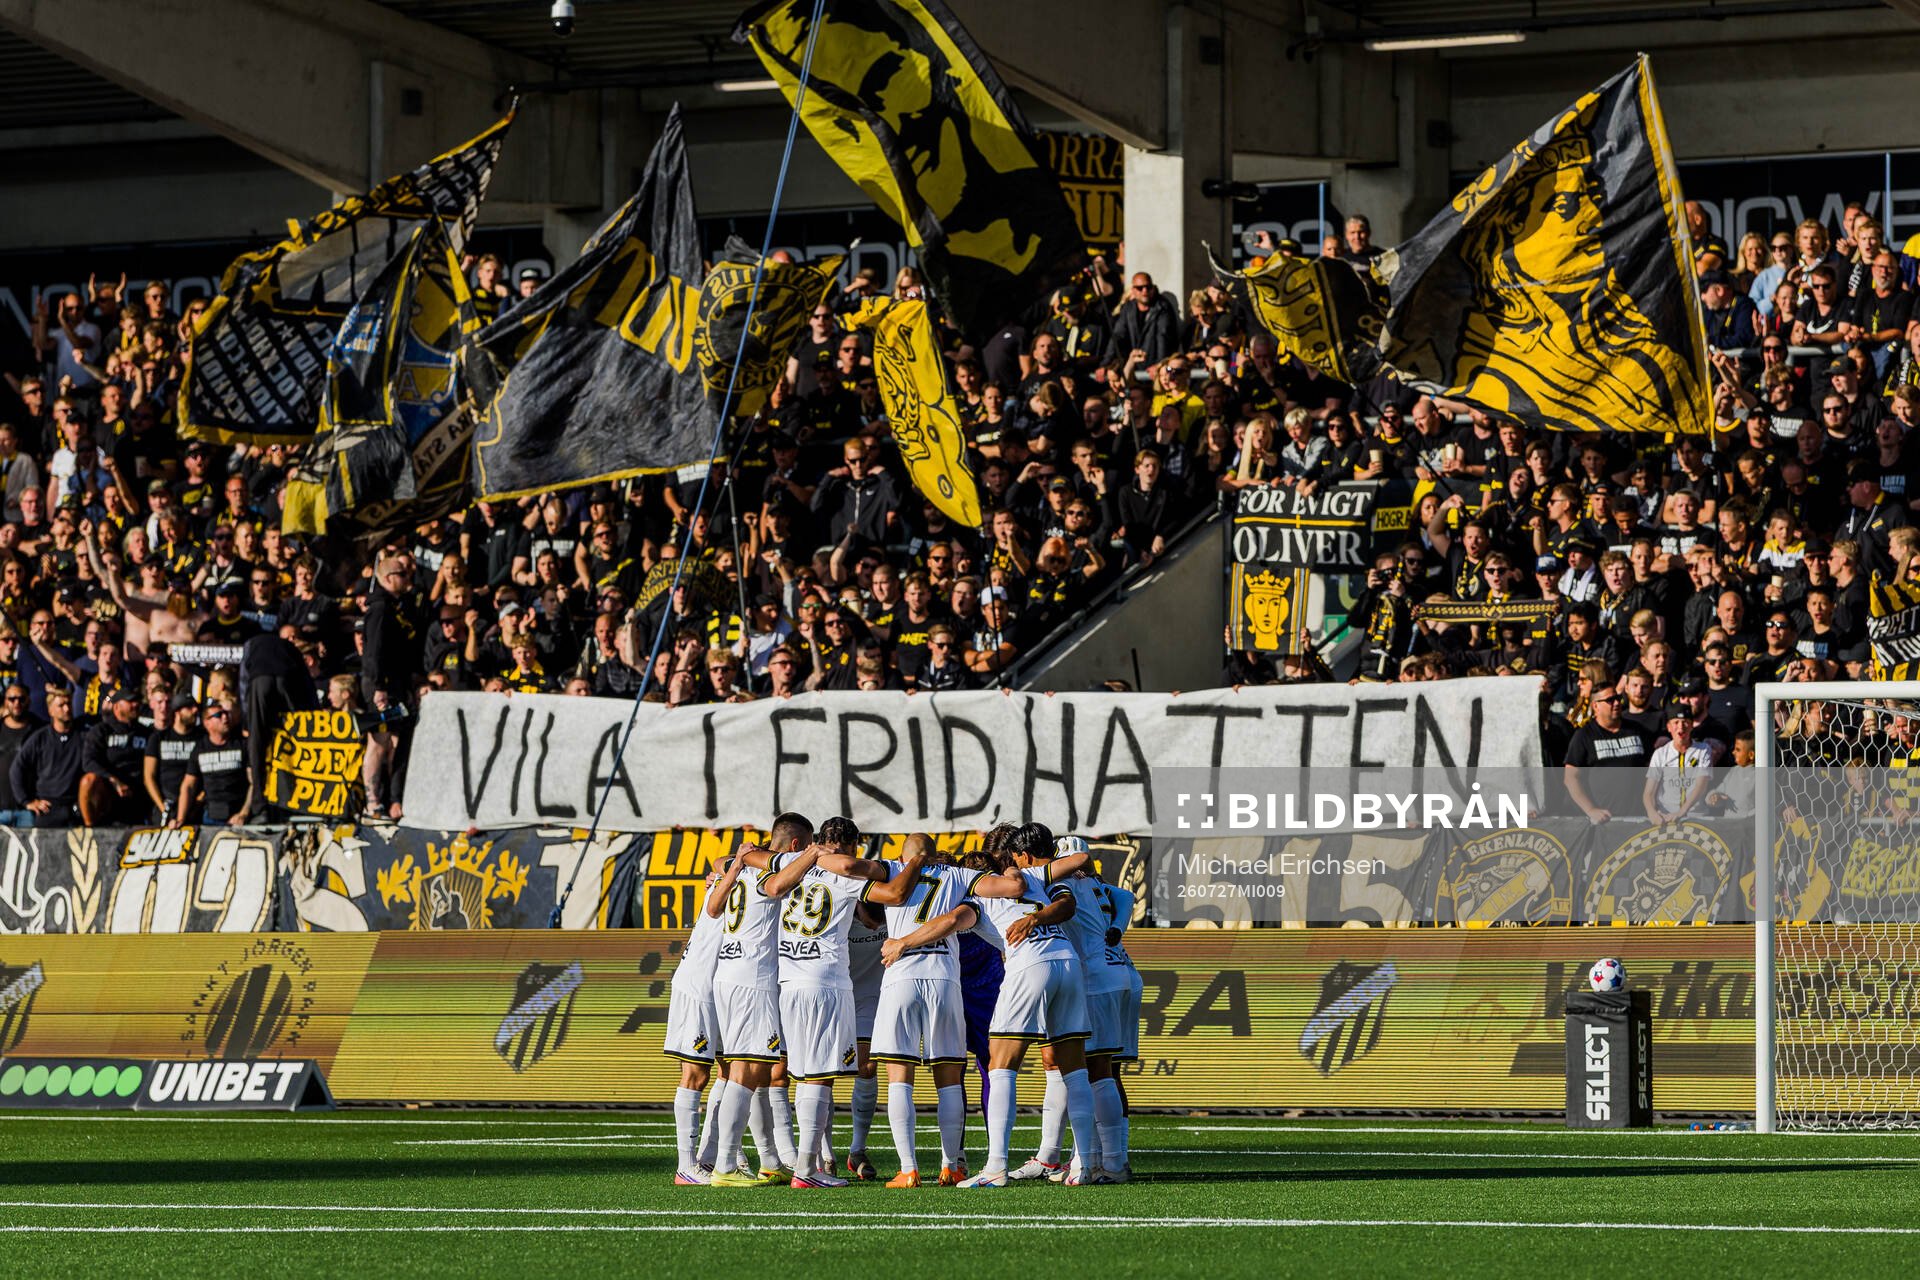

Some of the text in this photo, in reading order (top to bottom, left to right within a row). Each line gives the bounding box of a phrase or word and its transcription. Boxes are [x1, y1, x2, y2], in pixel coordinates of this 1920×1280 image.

[1237, 484, 1287, 514] FÖR
[1233, 525, 1365, 566] OLIVER
[456, 705, 642, 820] VILA
[702, 711, 718, 820] I
[783, 882, 833, 937] 29
[915, 875, 942, 923] 7
[778, 940, 820, 956] SVEA
[149, 1062, 305, 1102] UNIBET
[1585, 1023, 1610, 1121] SELECT
[1637, 1020, 1647, 1110] SELECT
